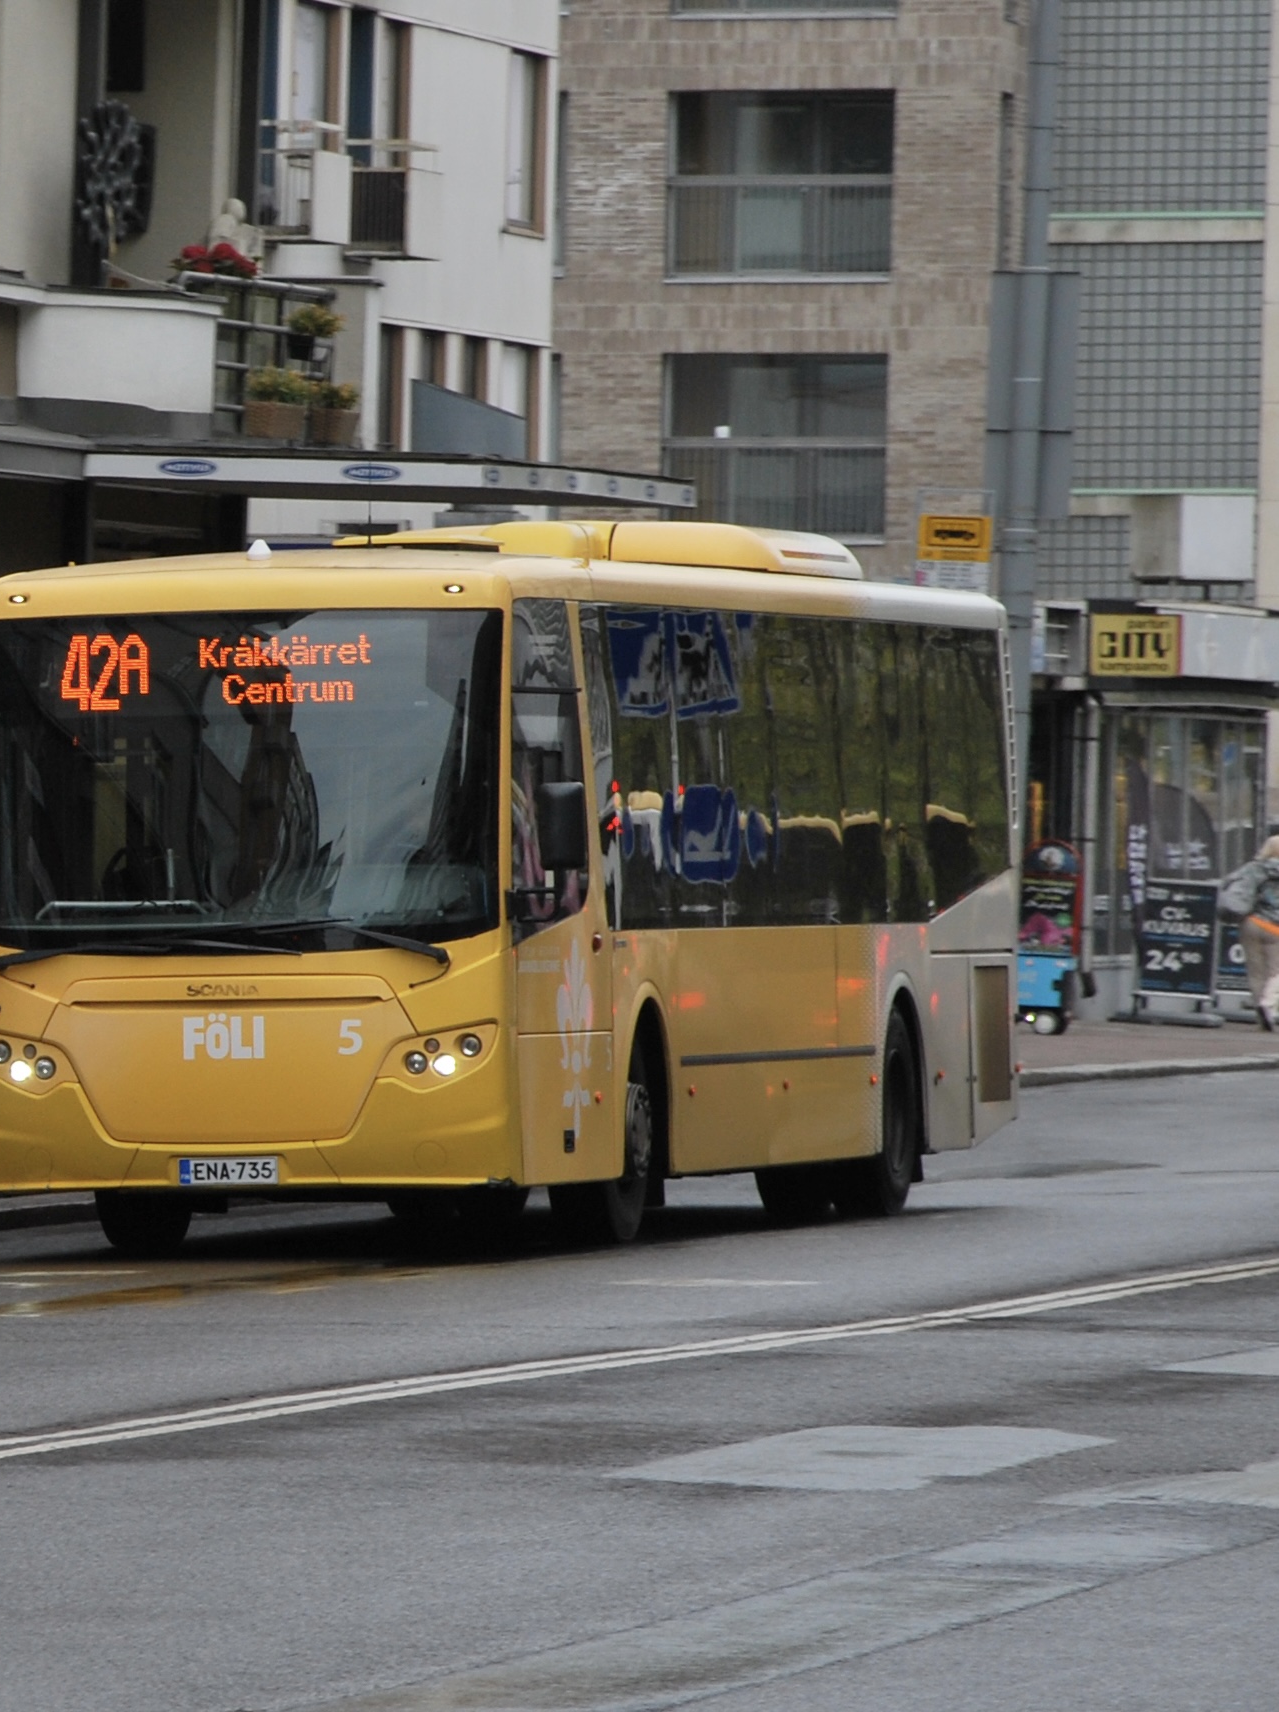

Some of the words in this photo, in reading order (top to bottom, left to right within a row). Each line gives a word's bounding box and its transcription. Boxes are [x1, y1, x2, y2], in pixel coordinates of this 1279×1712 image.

[199, 634, 372, 668] Kråkkärret
[1099, 632, 1172, 658] CITY
[61, 634, 150, 711] 42A
[222, 674, 354, 704] Centrum
[1142, 919, 1210, 938] KUVAUS
[186, 984, 259, 997] SCANIA
[182, 1012, 265, 1060] FÖLI
[337, 1019, 363, 1055] 5
[194, 1162, 272, 1181] ENA-735
